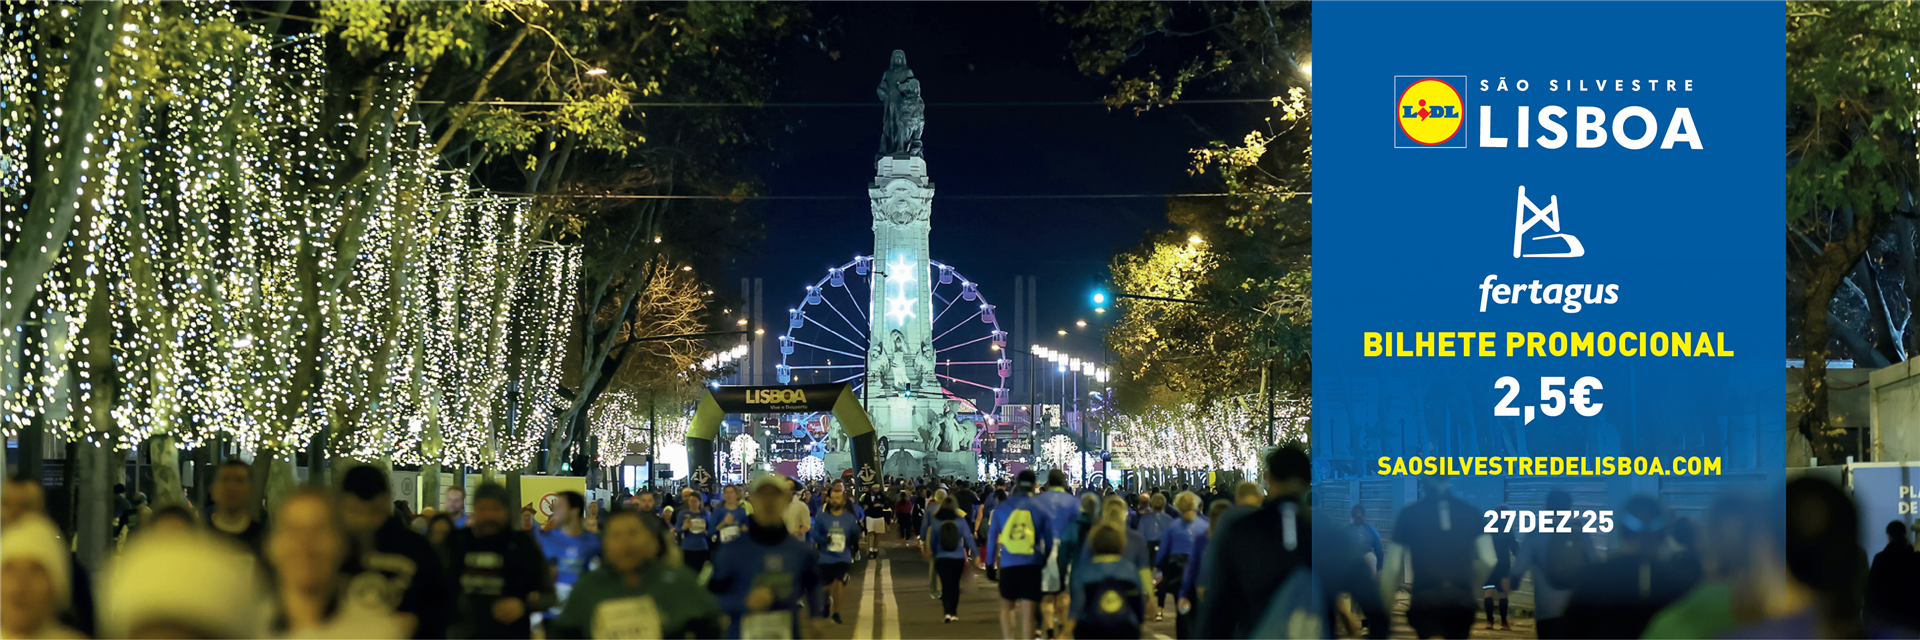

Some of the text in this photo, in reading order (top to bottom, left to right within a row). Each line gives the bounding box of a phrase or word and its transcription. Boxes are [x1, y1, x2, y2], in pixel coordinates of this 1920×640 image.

[745, 388, 807, 404] LISBOA
[1899, 485, 1920, 499] PL
[1898, 501, 1918, 515] DE
